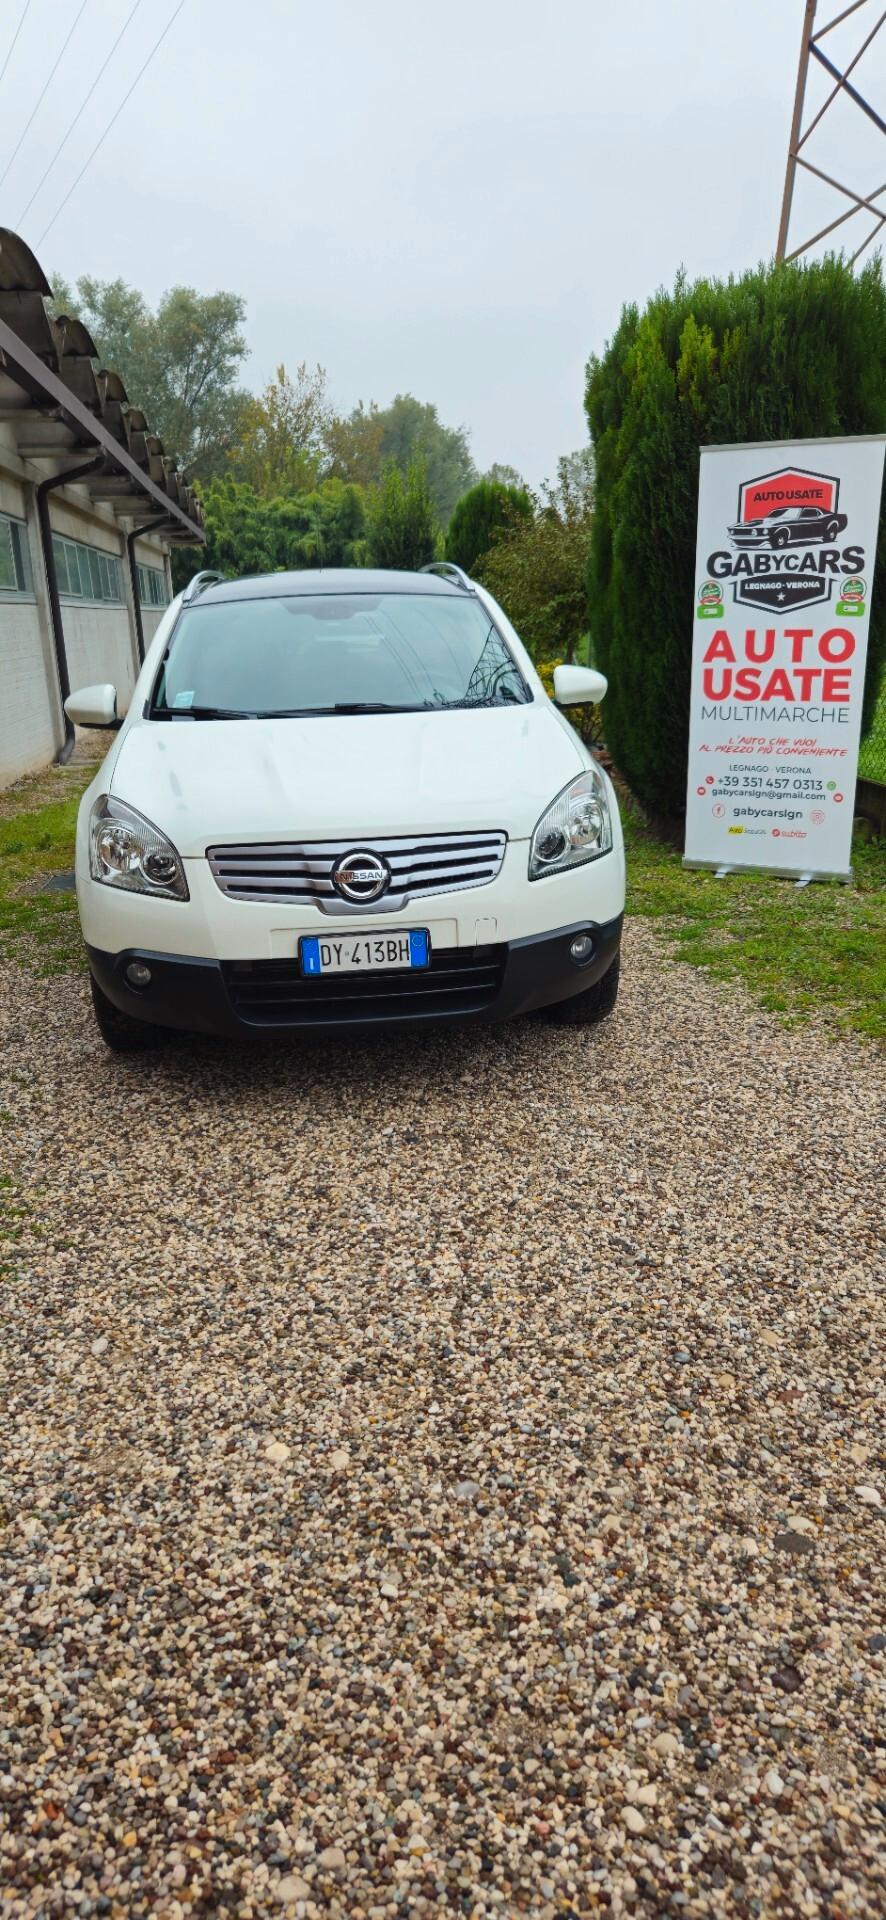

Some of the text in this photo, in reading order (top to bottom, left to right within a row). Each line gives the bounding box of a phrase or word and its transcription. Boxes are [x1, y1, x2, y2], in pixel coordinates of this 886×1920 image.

[754, 489, 823, 502] AUTO USATE
[706, 546, 865, 579] GABYCARS
[744, 581, 820, 590] LEGNAGO VERONA
[702, 628, 856, 664] AUTO
[703, 668, 852, 702] USATE
[701, 705, 850, 723] MULTIMARCHE
[769, 737, 789, 746] CHE
[793, 738, 817, 746] VUOI
[698, 744, 712, 753] AL
[714, 745, 753, 754] PREZZO
[776, 747, 849, 757] CONVENIENTE
[729, 764, 812, 775] LEGNAGO VERONA
[718, 775, 823, 791] +39 351 457 0313
[711, 787, 826, 801] gabycarsign@gmail.com
[733, 806, 803, 820] gabycarsign
[338, 871, 384, 881] NISSAN
[320, 943, 343, 966] DY
[351, 940, 410, 964] 413BH
